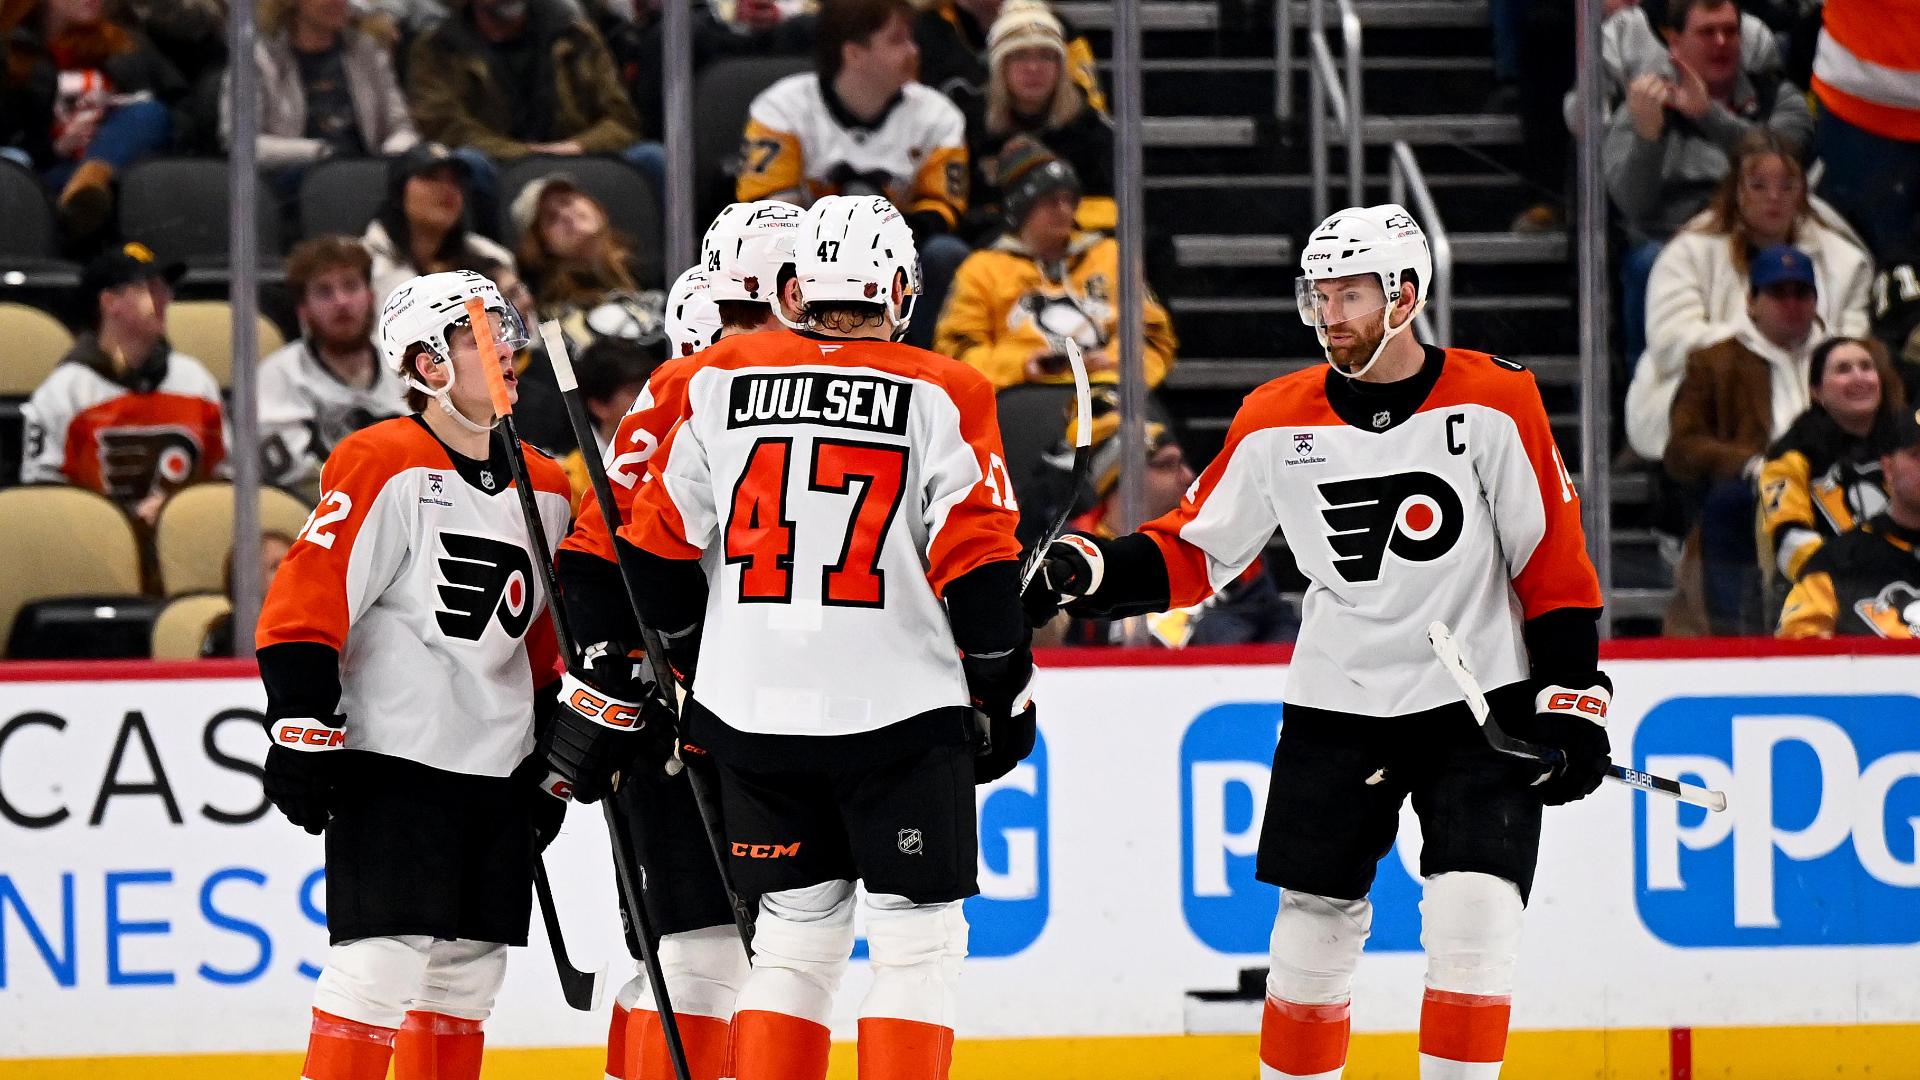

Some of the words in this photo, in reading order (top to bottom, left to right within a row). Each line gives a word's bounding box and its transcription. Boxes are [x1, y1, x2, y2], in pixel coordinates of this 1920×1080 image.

[708, 249, 721, 272] 24
[817, 240, 841, 263] 47
[1307, 253, 1332, 261] CCM
[470, 285, 495, 294] CCM
[384, 299, 416, 327] CHEVROLET
[735, 377, 899, 428] JUULSEN
[1446, 413, 1467, 456] C
[984, 452, 1019, 511] 47
[724, 436, 911, 609] 47
[569, 688, 644, 728] CC
[280, 725, 346, 748] CCM
[1645, 714, 1920, 928] PPG
[731, 841, 801, 859] CCM
